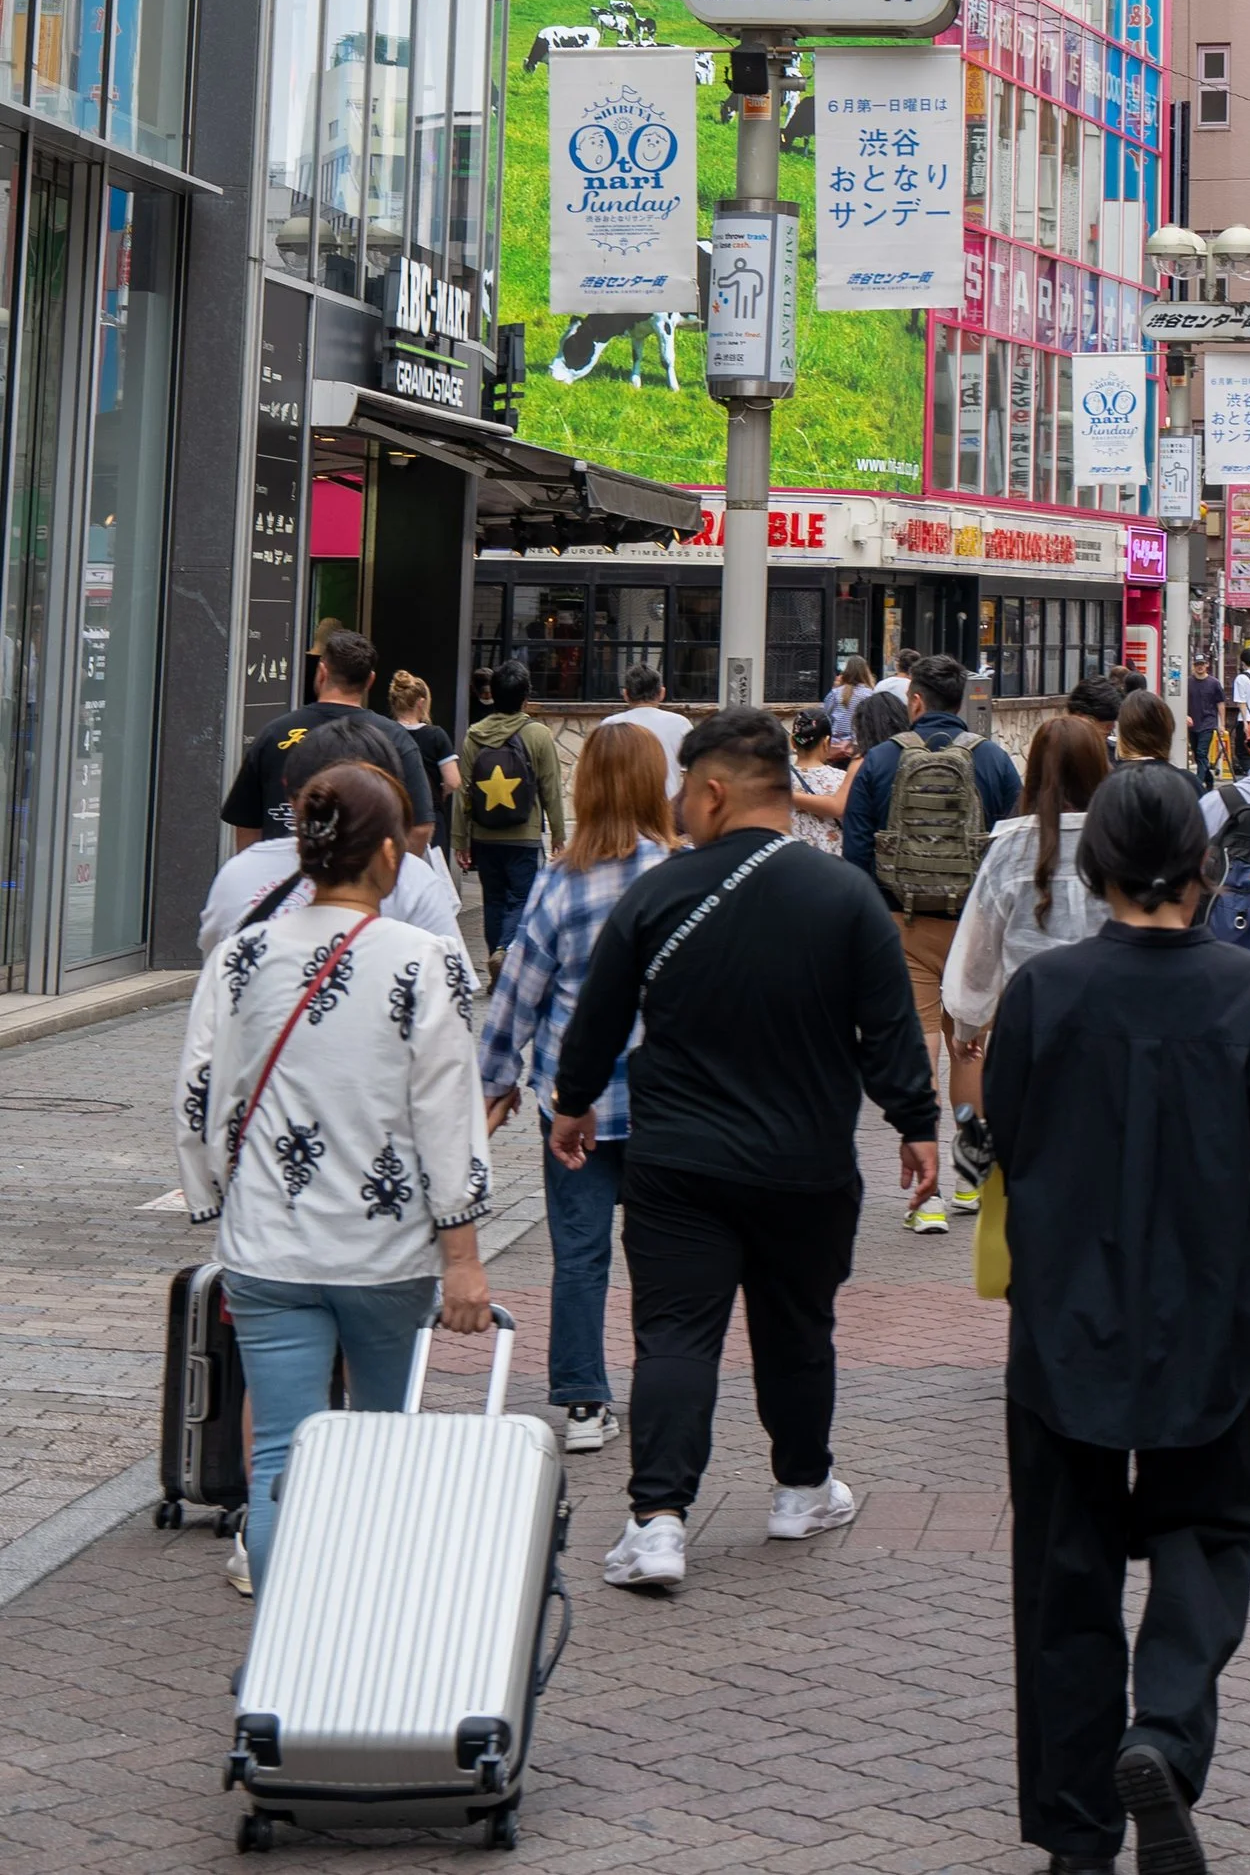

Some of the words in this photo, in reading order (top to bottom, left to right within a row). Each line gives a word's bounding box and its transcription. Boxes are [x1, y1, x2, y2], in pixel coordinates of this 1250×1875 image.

[594, 105, 652, 123] SHIBUYA
[828, 98, 948, 113] 6月第一日曜日は
[859, 128, 920, 157] 渋谷
[829, 164, 948, 193] おとなり
[567, 191, 680, 220] Sunday
[829, 198, 950, 228] サンデー
[580, 275, 669, 288] 渋谷センター街
[846, 271, 934, 285] 渋谷センター街
[396, 256, 471, 342] ABC-MART
[396, 360, 433, 400] GRAND
[434, 374, 464, 408] STAGE
[1082, 425, 1138, 441] Sunday
